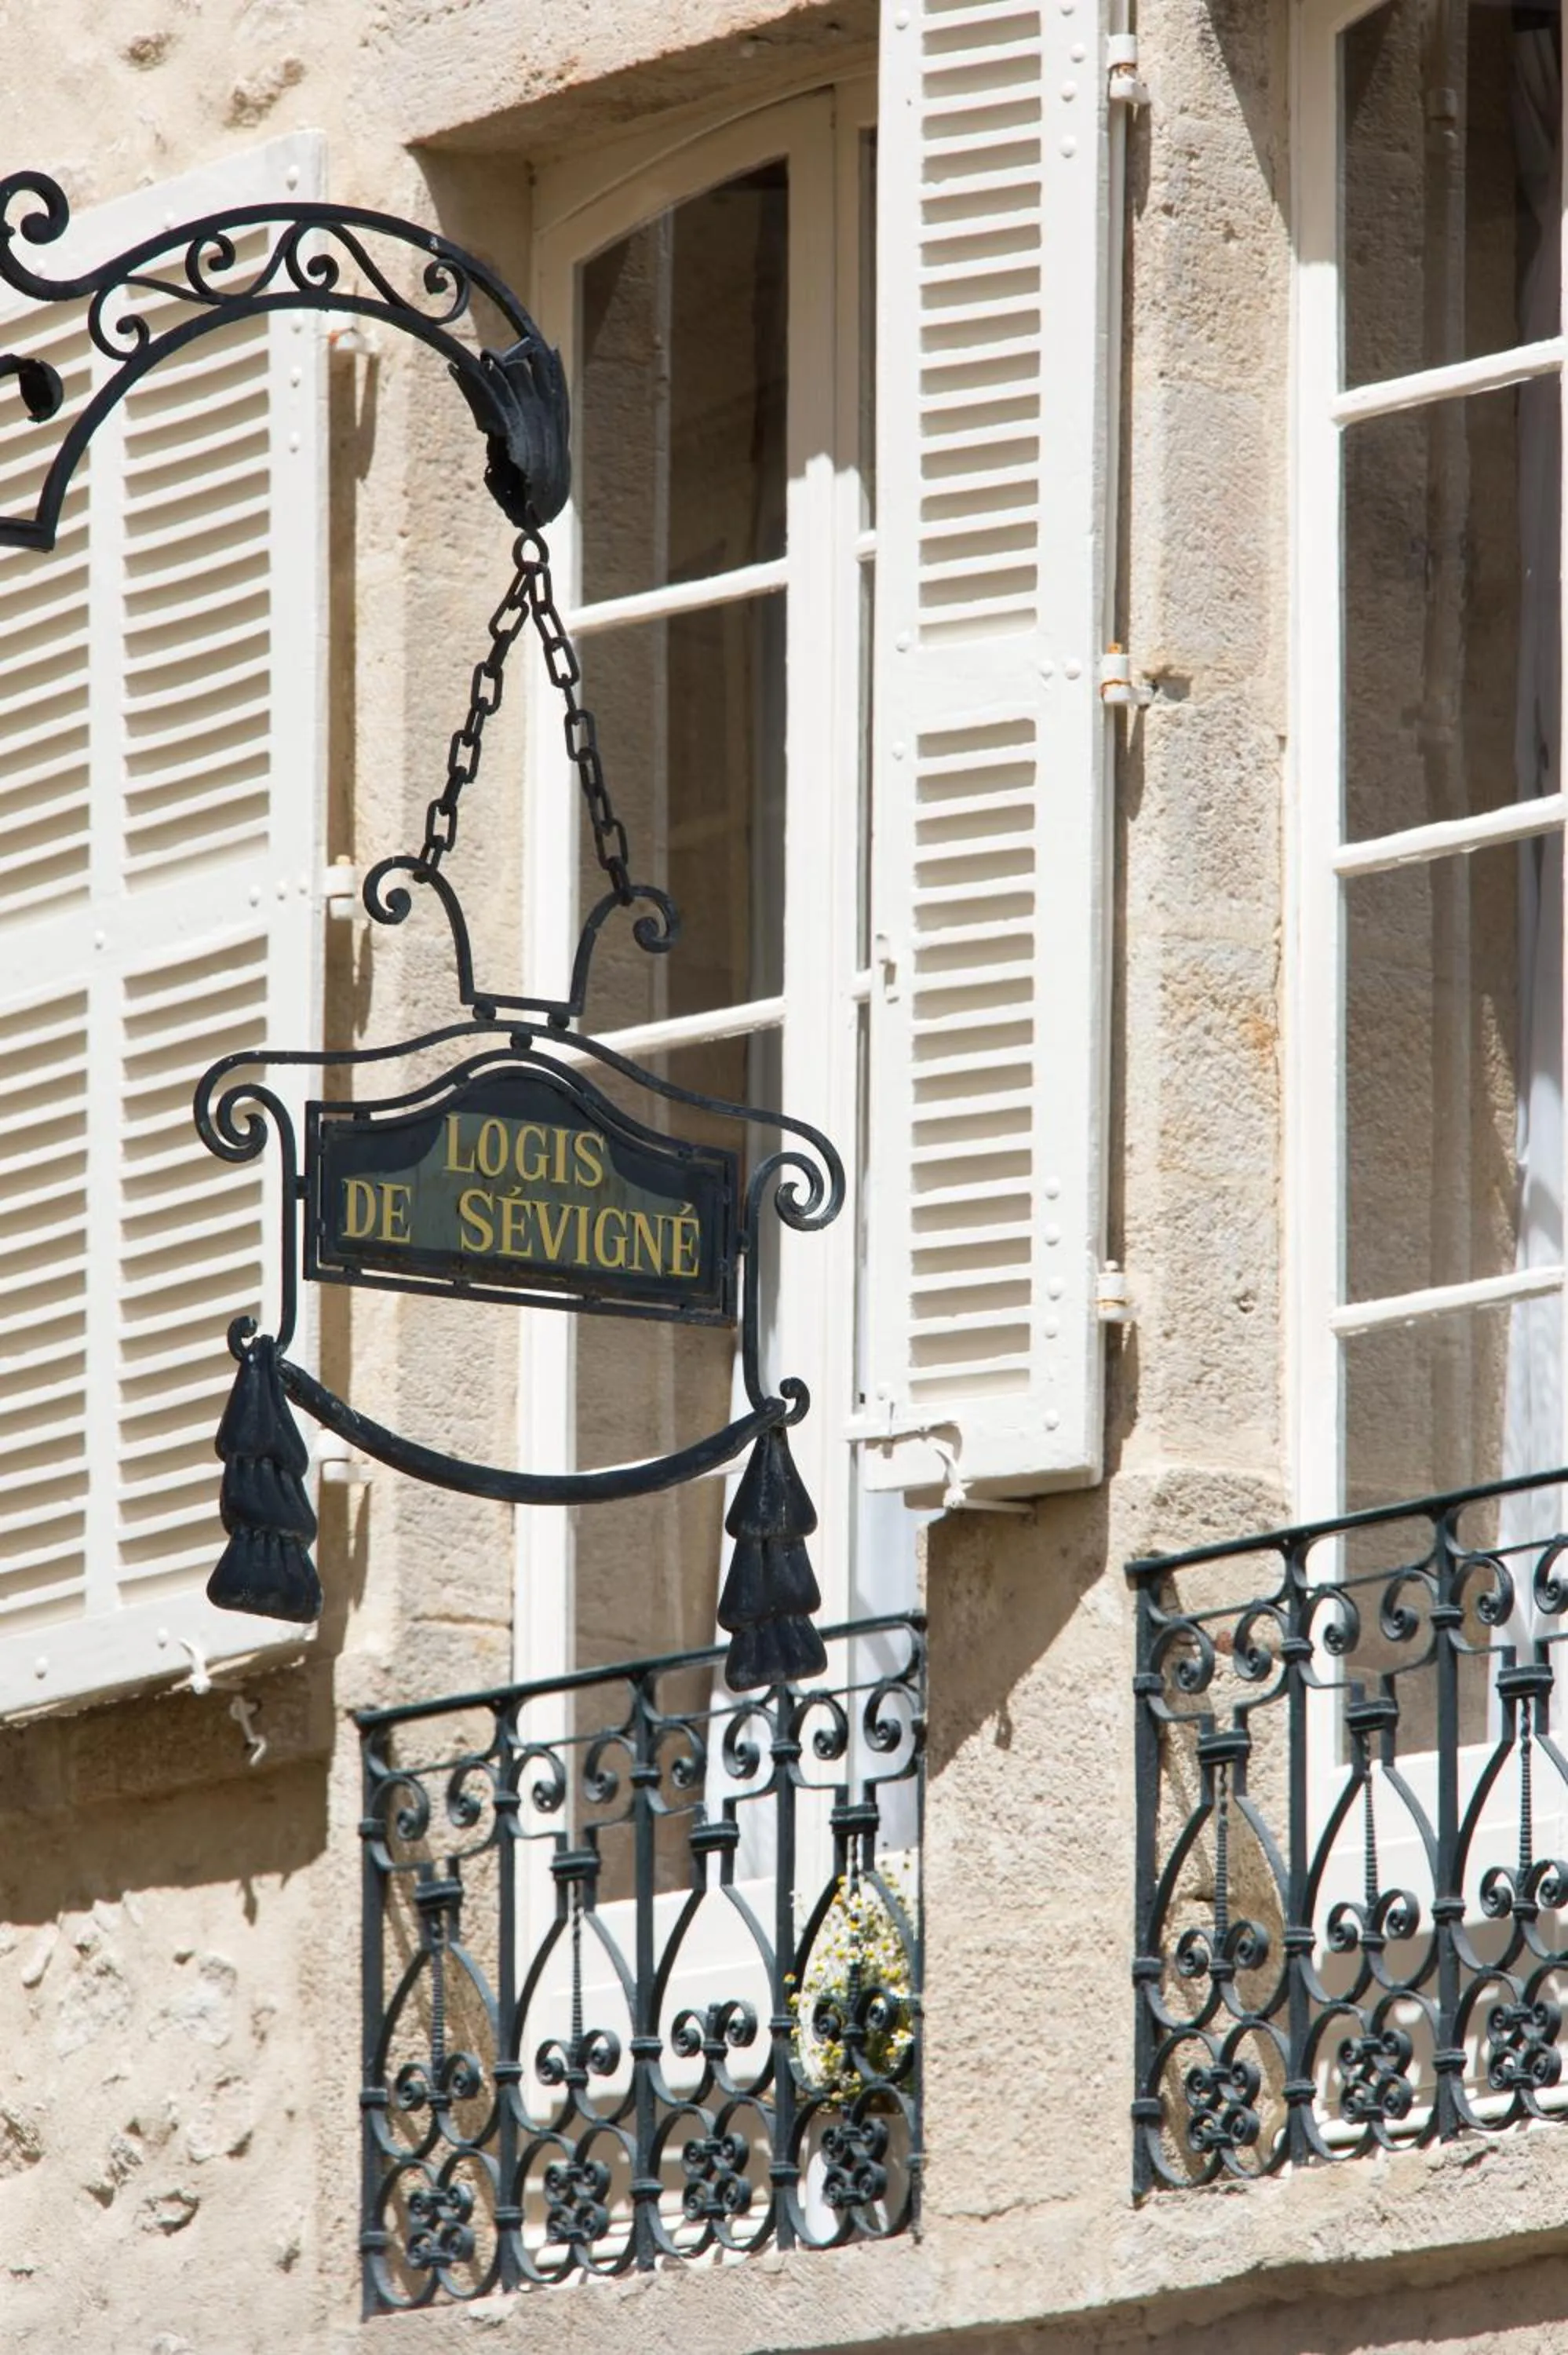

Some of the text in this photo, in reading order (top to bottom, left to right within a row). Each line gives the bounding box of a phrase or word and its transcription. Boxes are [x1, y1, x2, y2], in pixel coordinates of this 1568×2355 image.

[444, 1113, 605, 1188] LOGIS
[341, 1178, 700, 1278] DE SÉVIGNÉ
